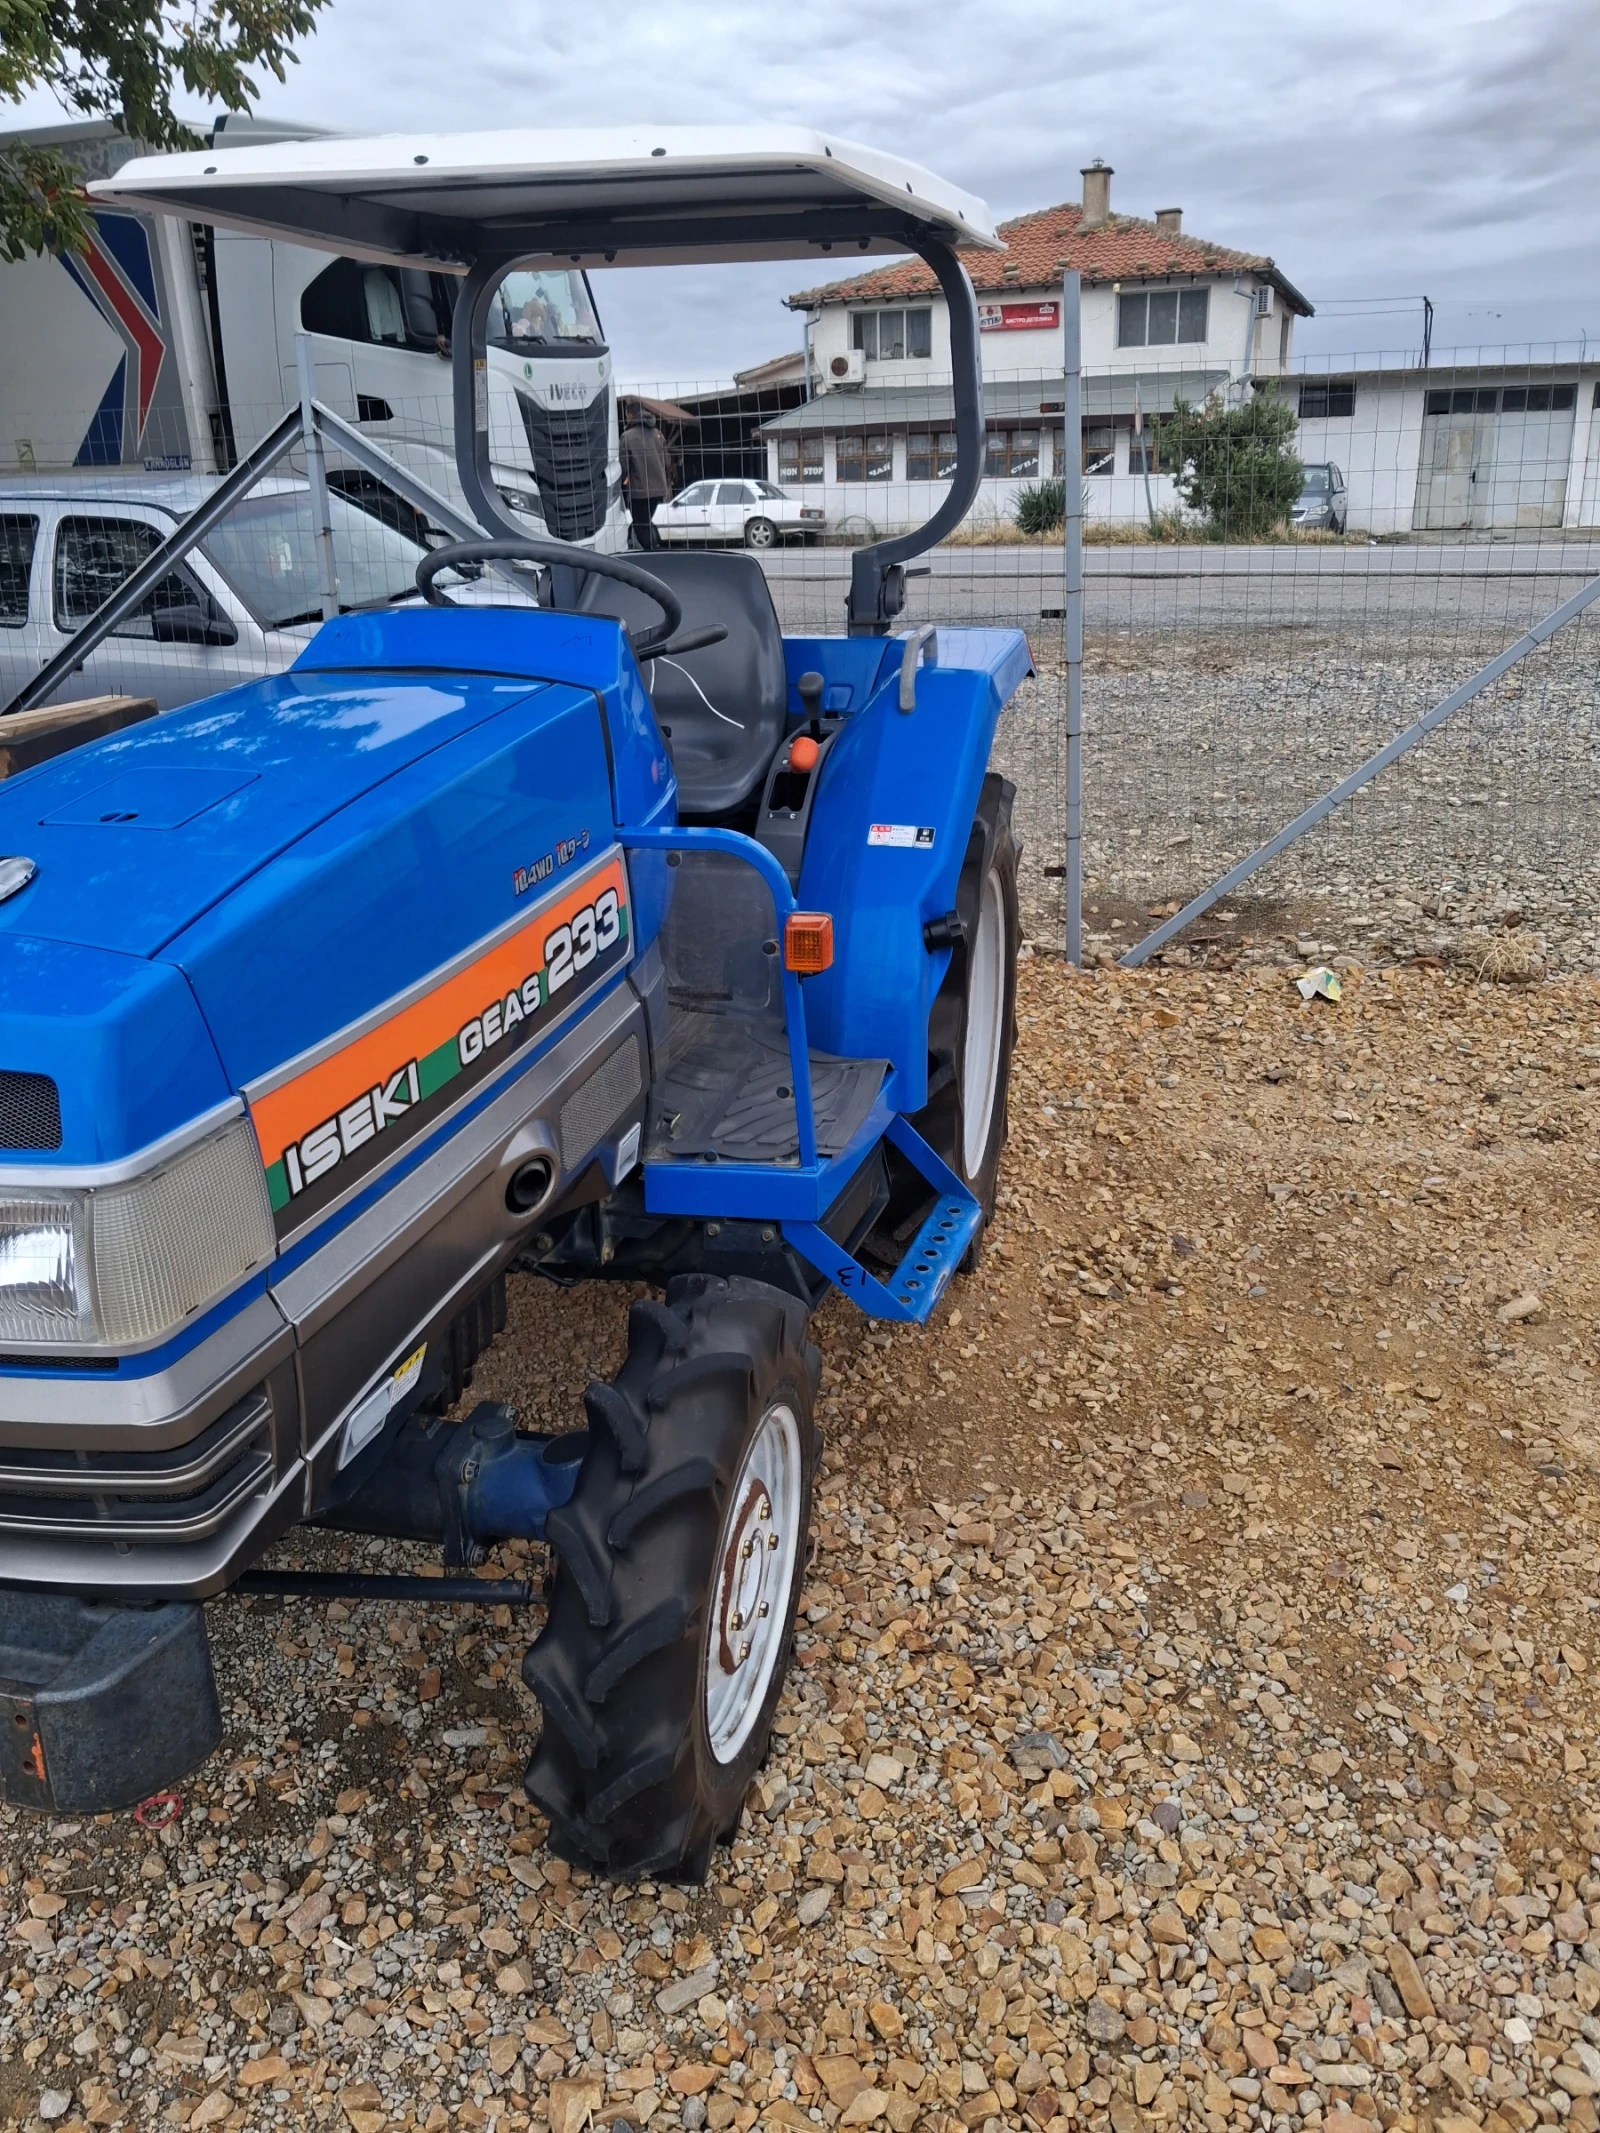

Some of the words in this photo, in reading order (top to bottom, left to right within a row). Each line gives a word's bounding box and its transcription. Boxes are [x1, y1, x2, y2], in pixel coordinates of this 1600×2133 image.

[549, 383, 587, 400] IVECO
[780, 467, 798, 476] NON
[803, 466, 824, 476] STOP
[1010, 457, 1039, 474] СУПА
[284, 1059, 422, 1197] ISEKI
[458, 972, 541, 1067] GEAS
[544, 887, 620, 995] 233
